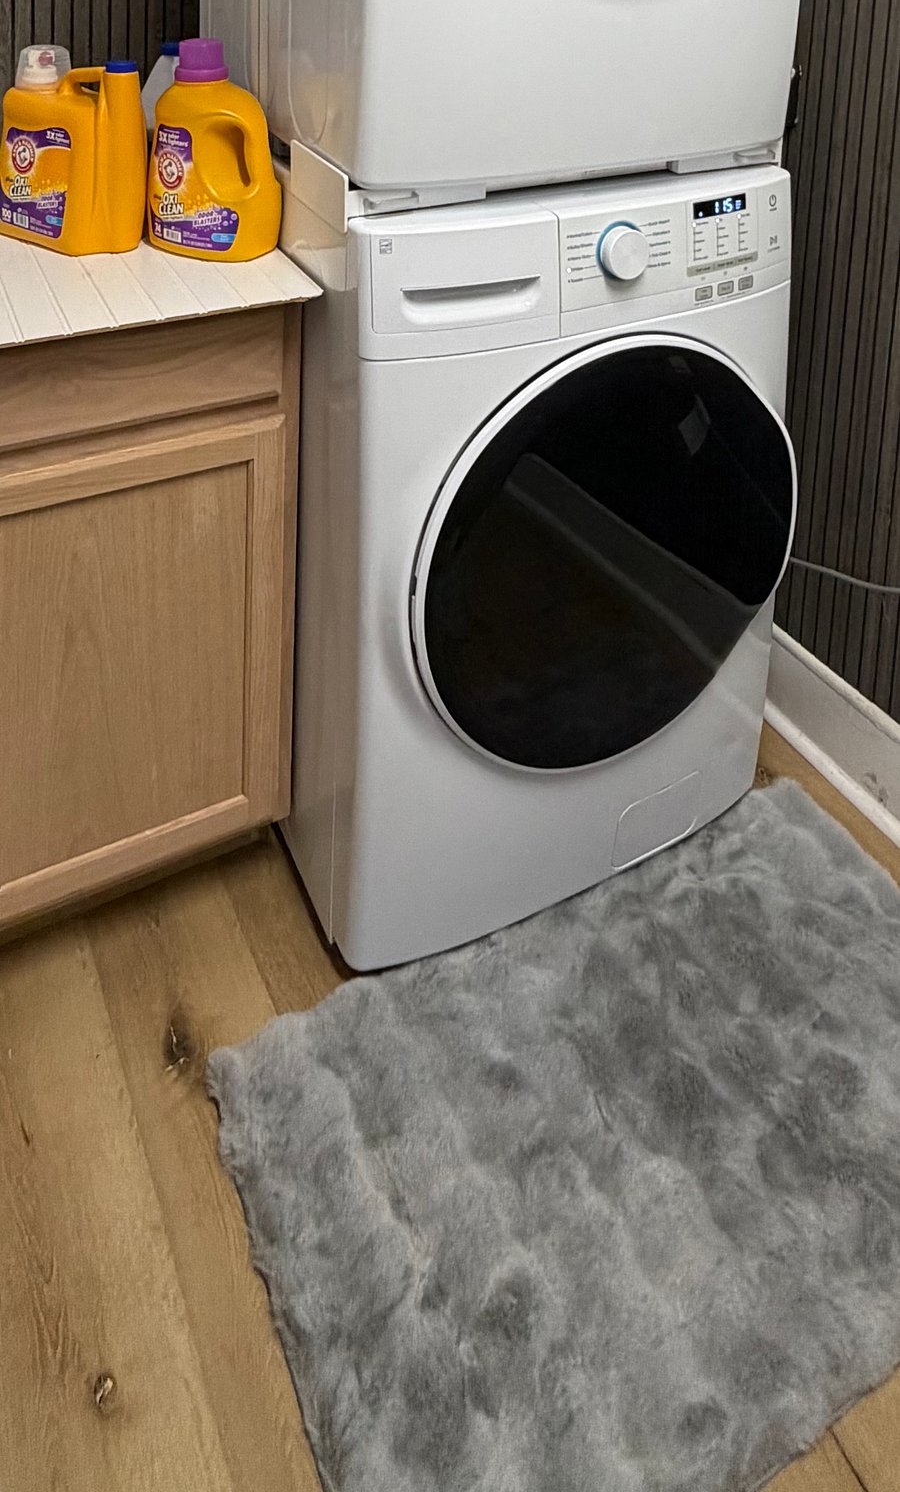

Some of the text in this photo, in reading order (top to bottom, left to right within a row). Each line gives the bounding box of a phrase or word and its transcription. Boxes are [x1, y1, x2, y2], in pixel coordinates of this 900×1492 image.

[46, 130, 56, 140] 3X
[14, 175, 28, 186] OXI
[10, 184, 32, 196] CLEAN
[163, 193, 178, 205] OXI
[158, 203, 184, 215] CLEAN
[197, 210, 214, 219] ODOR
[193, 216, 221, 227] BLASTERS
